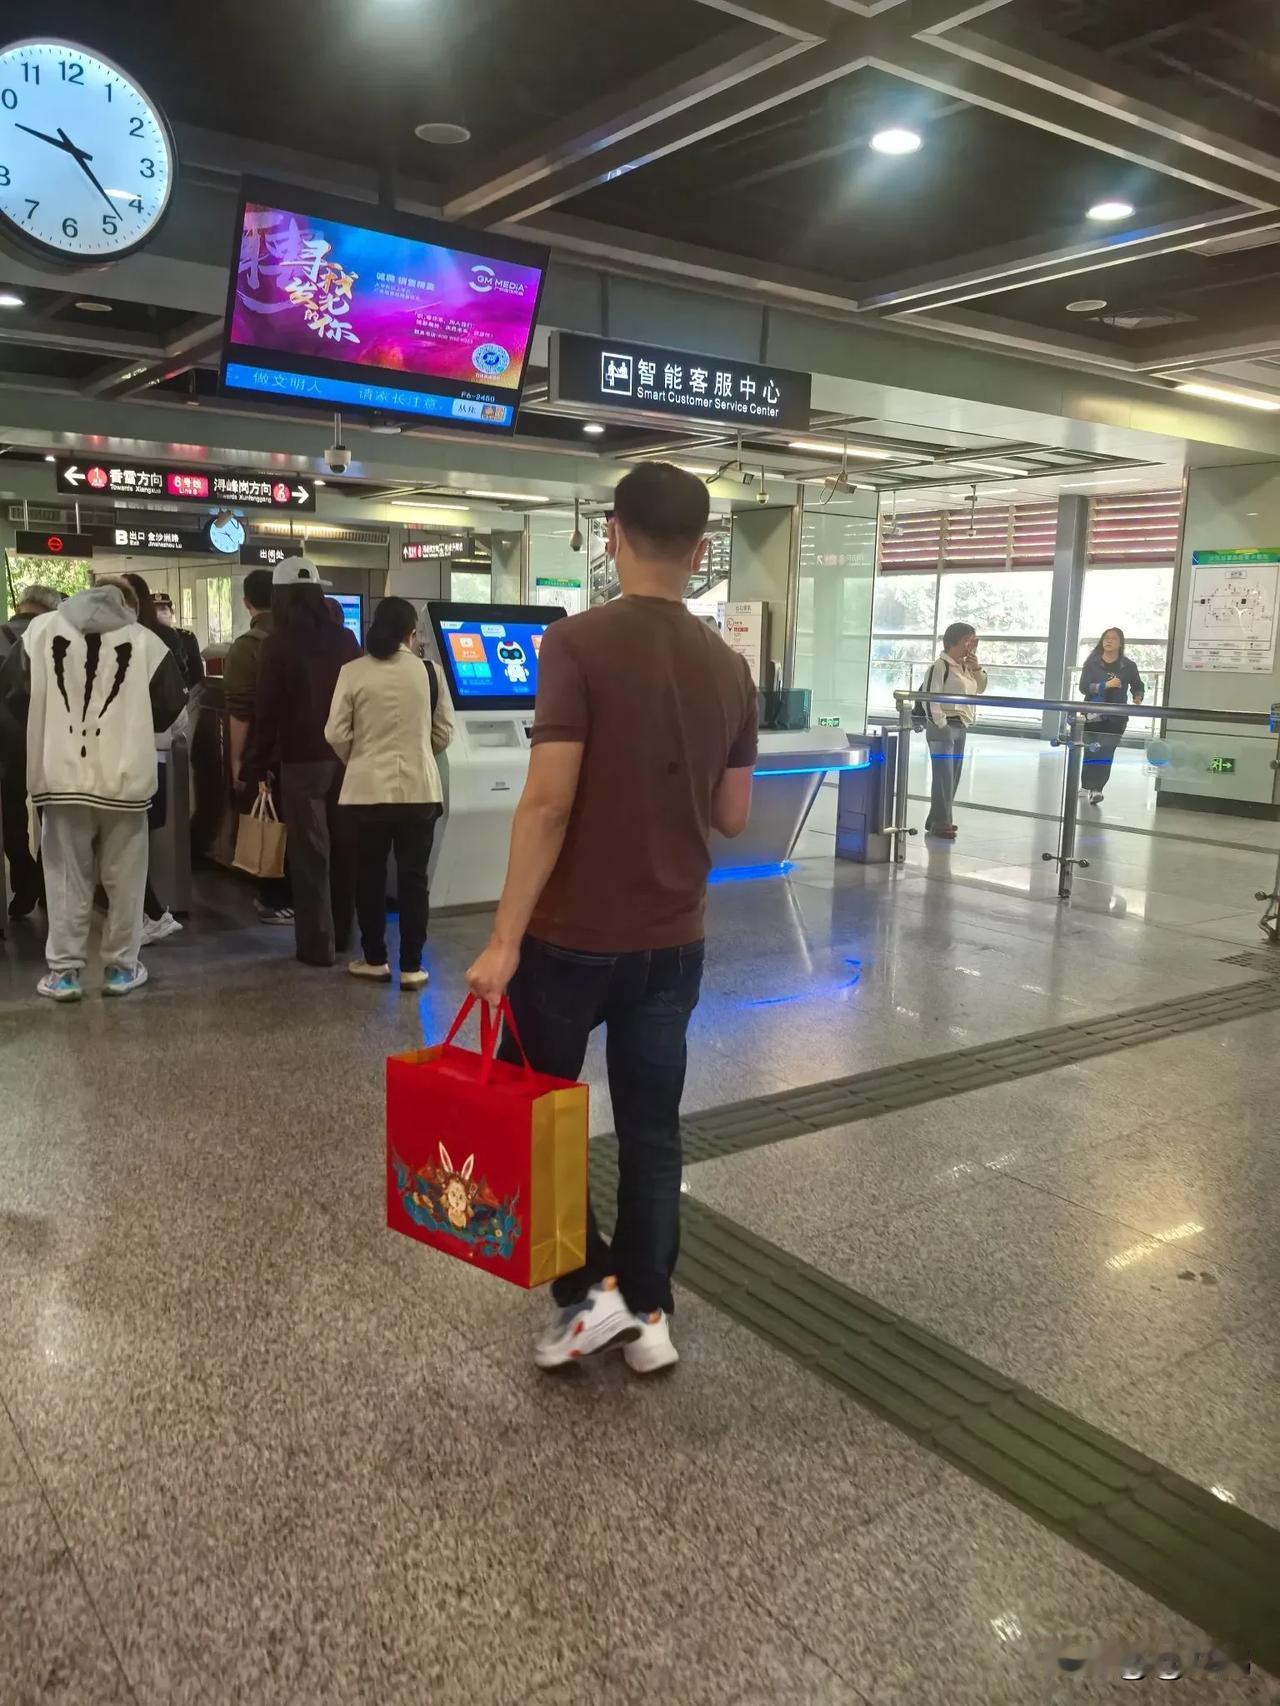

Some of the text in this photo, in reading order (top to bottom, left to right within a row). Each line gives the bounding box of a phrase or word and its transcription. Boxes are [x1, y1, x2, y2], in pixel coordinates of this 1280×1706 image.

[20, 62, 40, 85] 11
[59, 60, 84, 85] 12
[1, 88, 18, 109] 0
[104, 82, 112, 102] 1
[129, 117, 145, 138] 2
[139, 158, 155, 178] 3
[25, 198, 40, 219] 7
[128, 194, 144, 214] 4
[62, 217, 78, 238] 6
[102, 214, 118, 235] 5
[494, 279, 525, 292] MEDIA
[637, 358, 781, 405] 智能客服中心
[637, 386, 779, 417] Smart Customer Service Center
[110, 469, 163, 488] 香雪方向
[174, 476, 202, 489] 6号线
[115, 529, 128, 545] B
[129, 530, 145, 541] 出口
